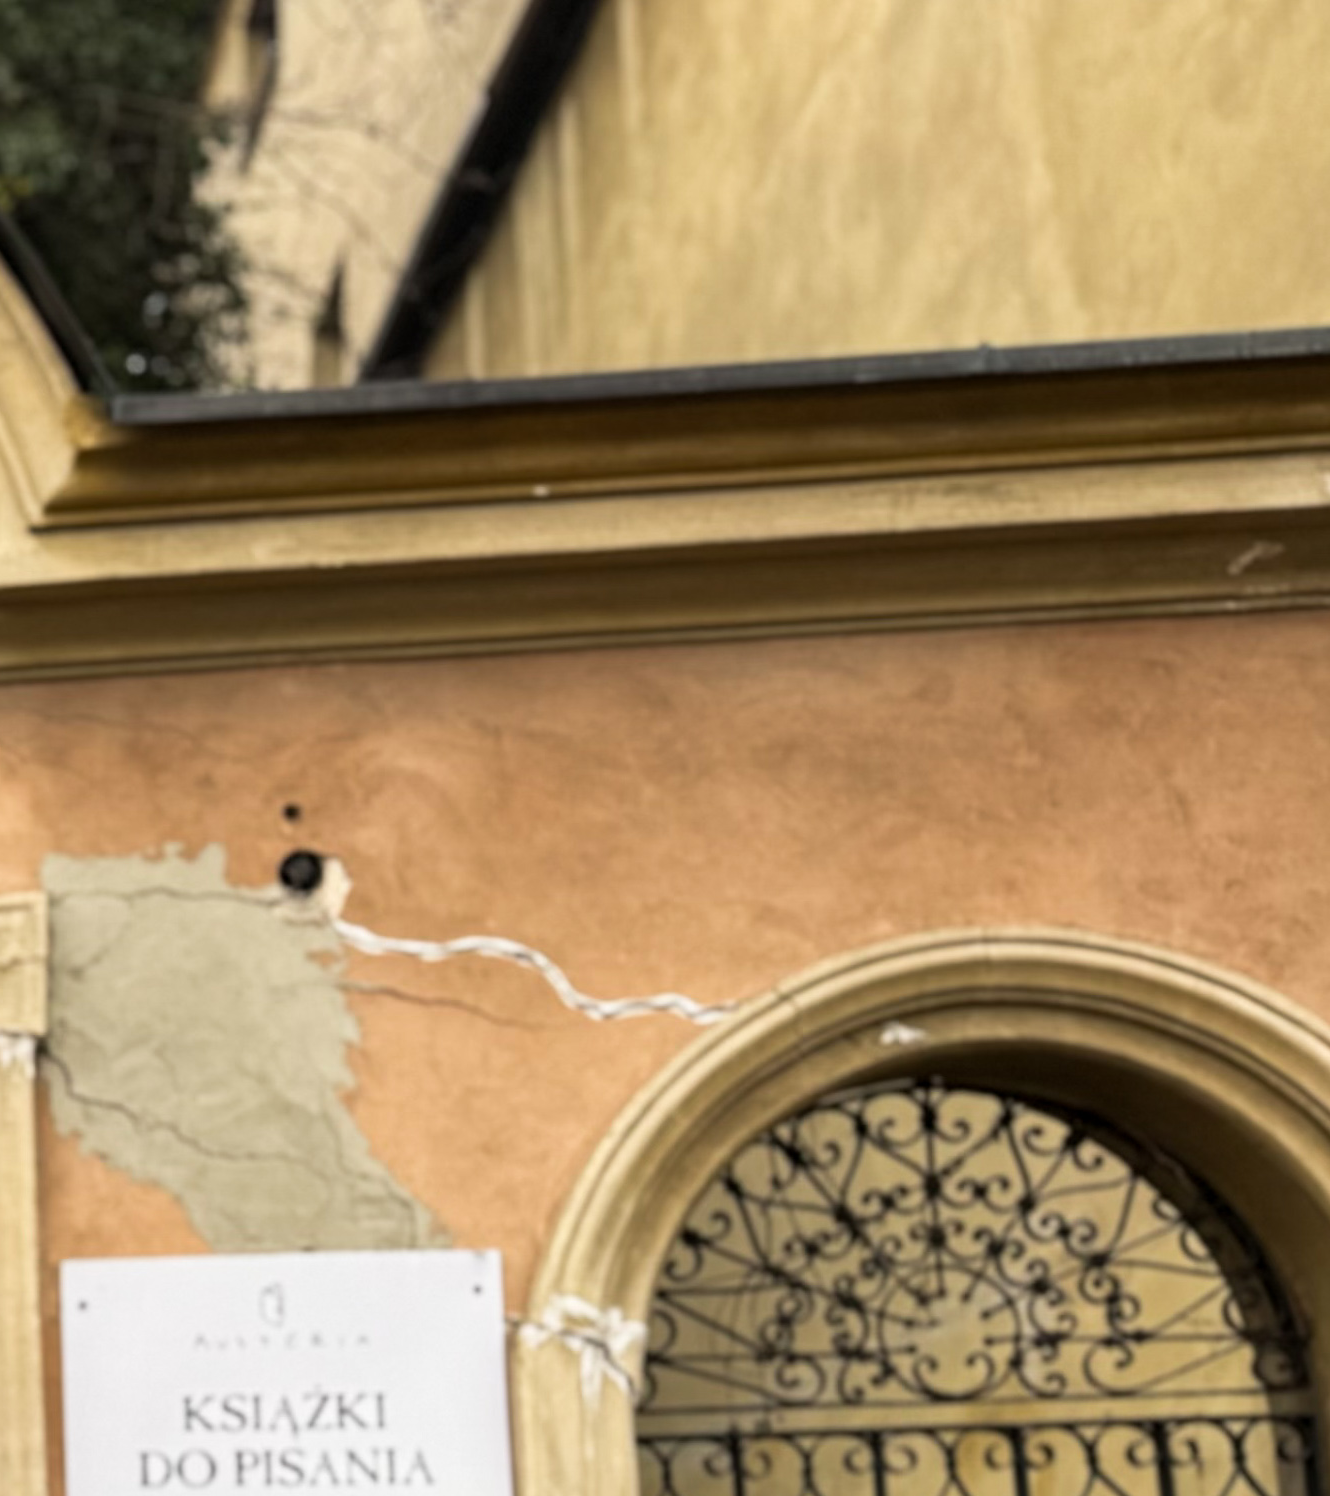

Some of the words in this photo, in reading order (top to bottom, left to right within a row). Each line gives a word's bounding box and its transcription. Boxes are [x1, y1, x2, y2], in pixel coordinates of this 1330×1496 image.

[182, 1386, 386, 1438] KSIĄŻKI
[140, 1451, 218, 1488] DO
[234, 1448, 434, 1487] PISANIA
